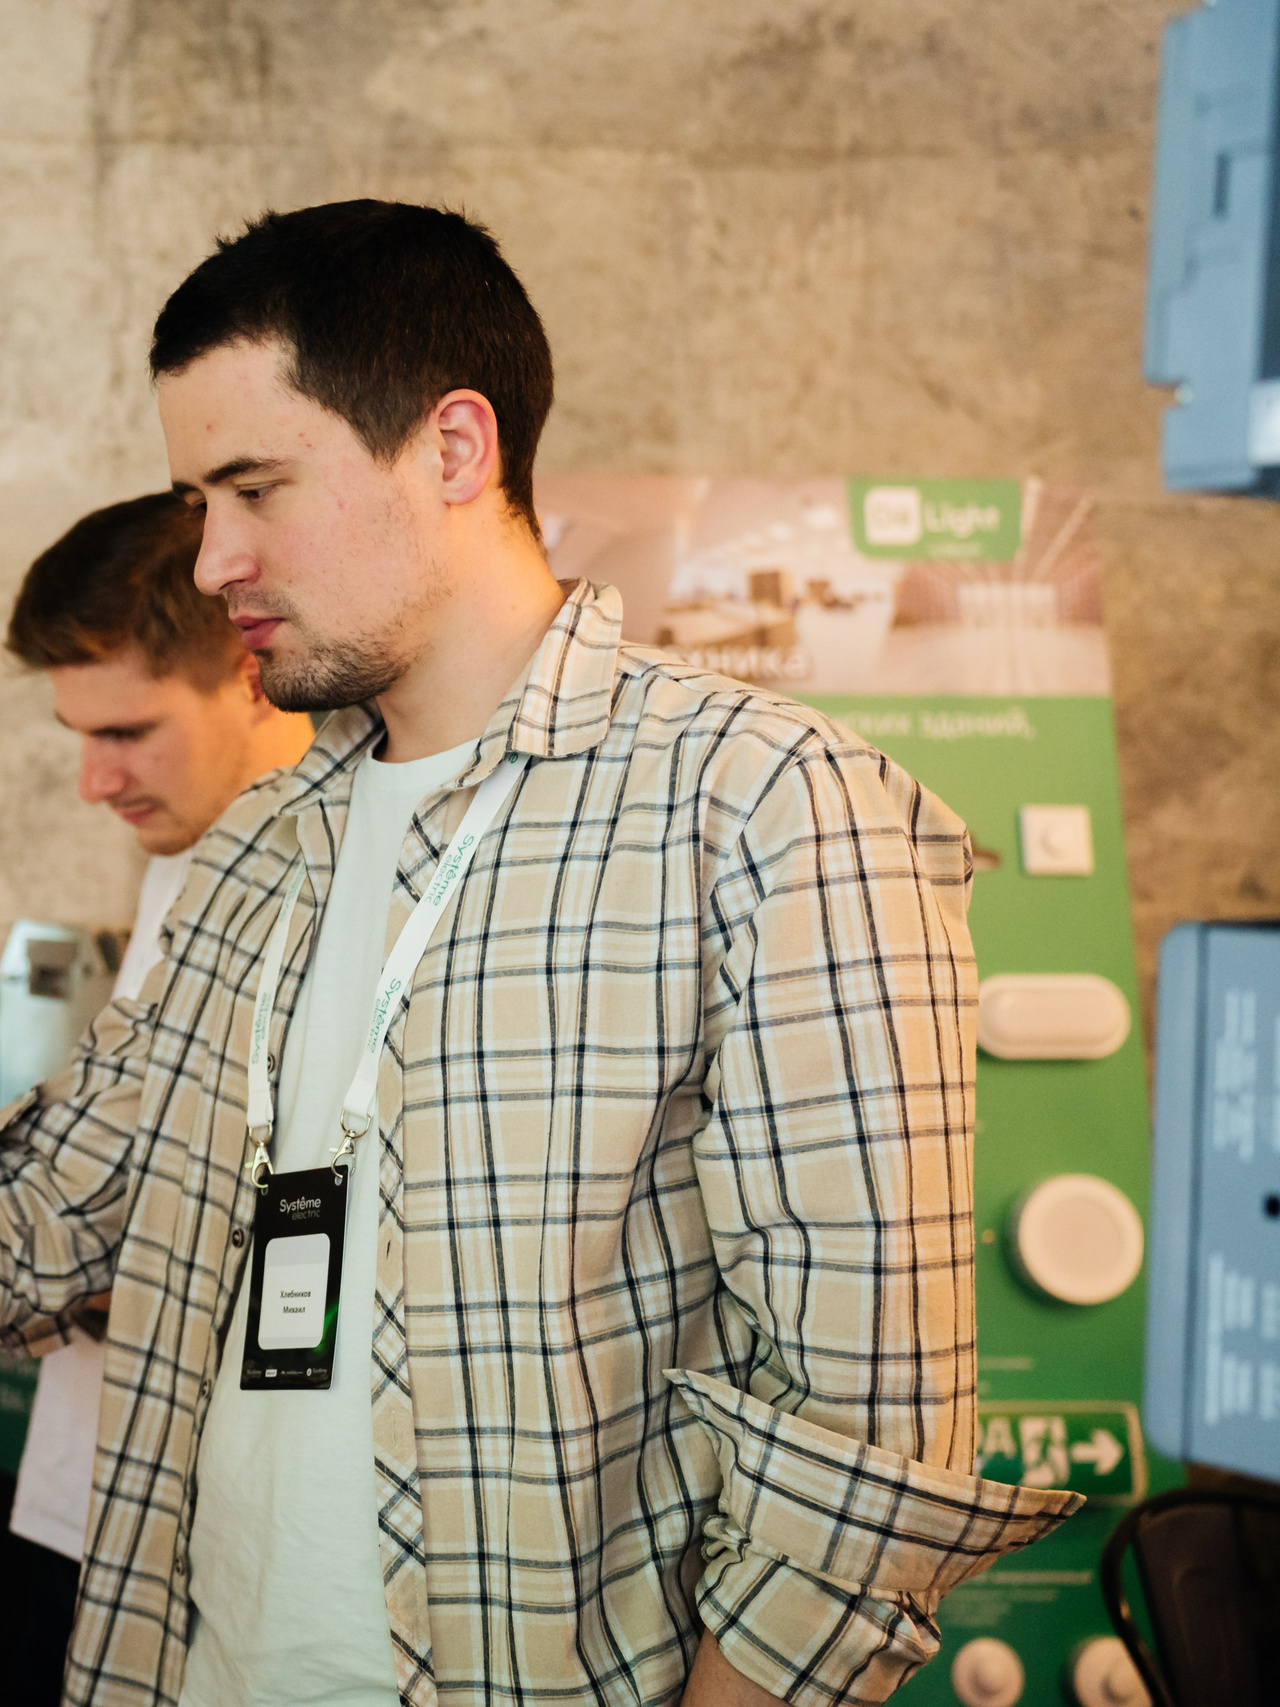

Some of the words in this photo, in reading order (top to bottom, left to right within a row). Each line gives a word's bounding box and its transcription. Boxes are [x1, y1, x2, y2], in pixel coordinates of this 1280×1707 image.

[424, 854, 454, 905] electric
[433, 833, 475, 907] Systême
[370, 977, 402, 1054] Systême
[279, 1196, 322, 1214] Systême
[280, 1289, 311, 1299] Хлебников
[282, 1306, 306, 1314] Михаил
